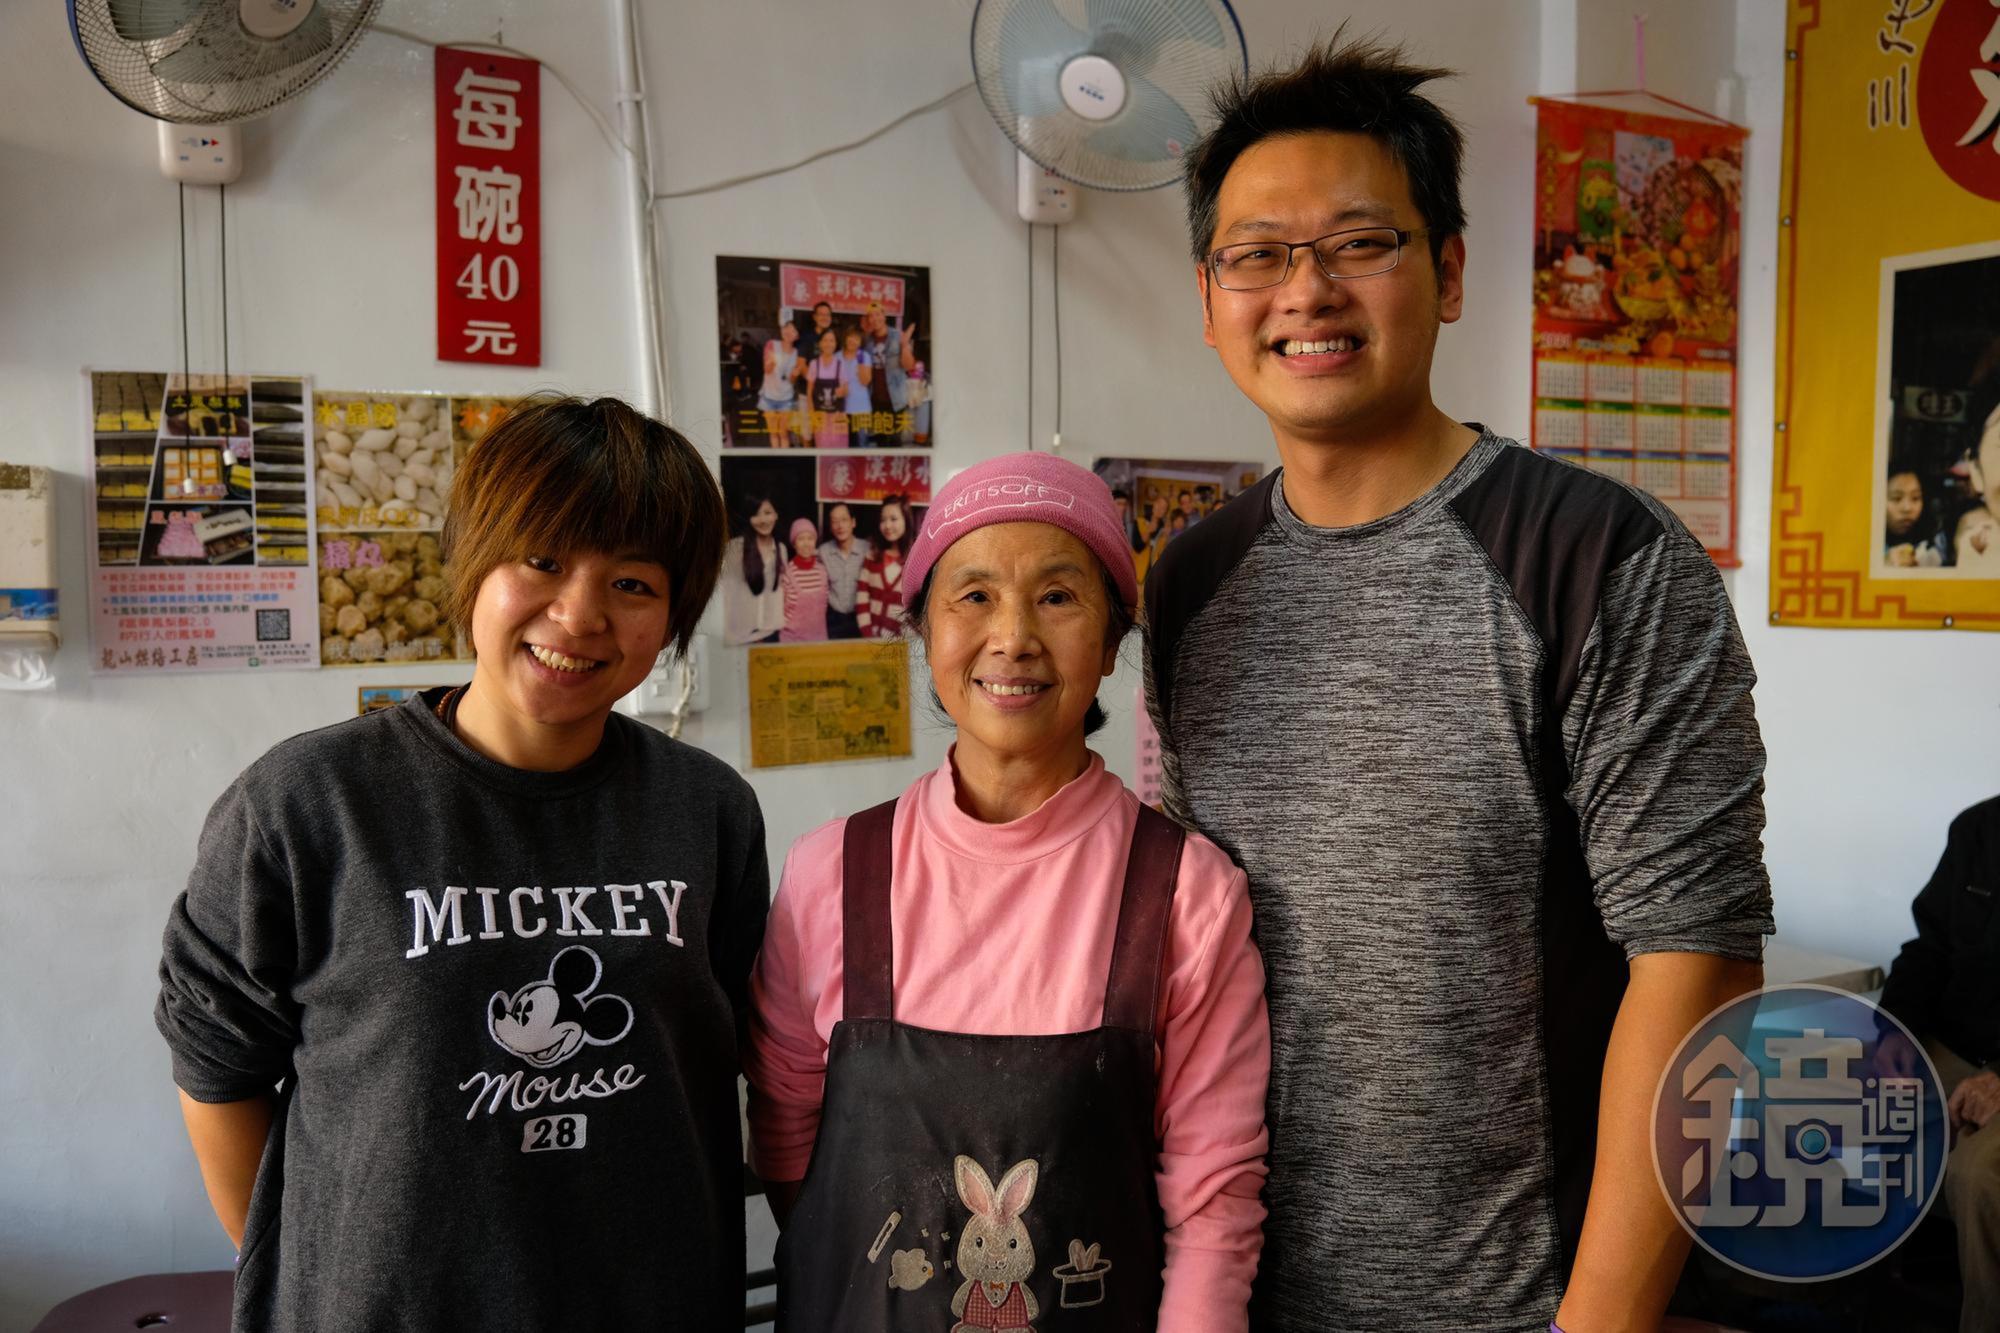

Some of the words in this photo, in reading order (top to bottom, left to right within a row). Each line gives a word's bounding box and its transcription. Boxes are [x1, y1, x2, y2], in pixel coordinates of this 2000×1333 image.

[453, 66, 523, 356] 每碗40元
[405, 879, 688, 960] MICKEY
[458, 1064, 646, 1120] Mouse
[530, 1117, 577, 1149] 28
